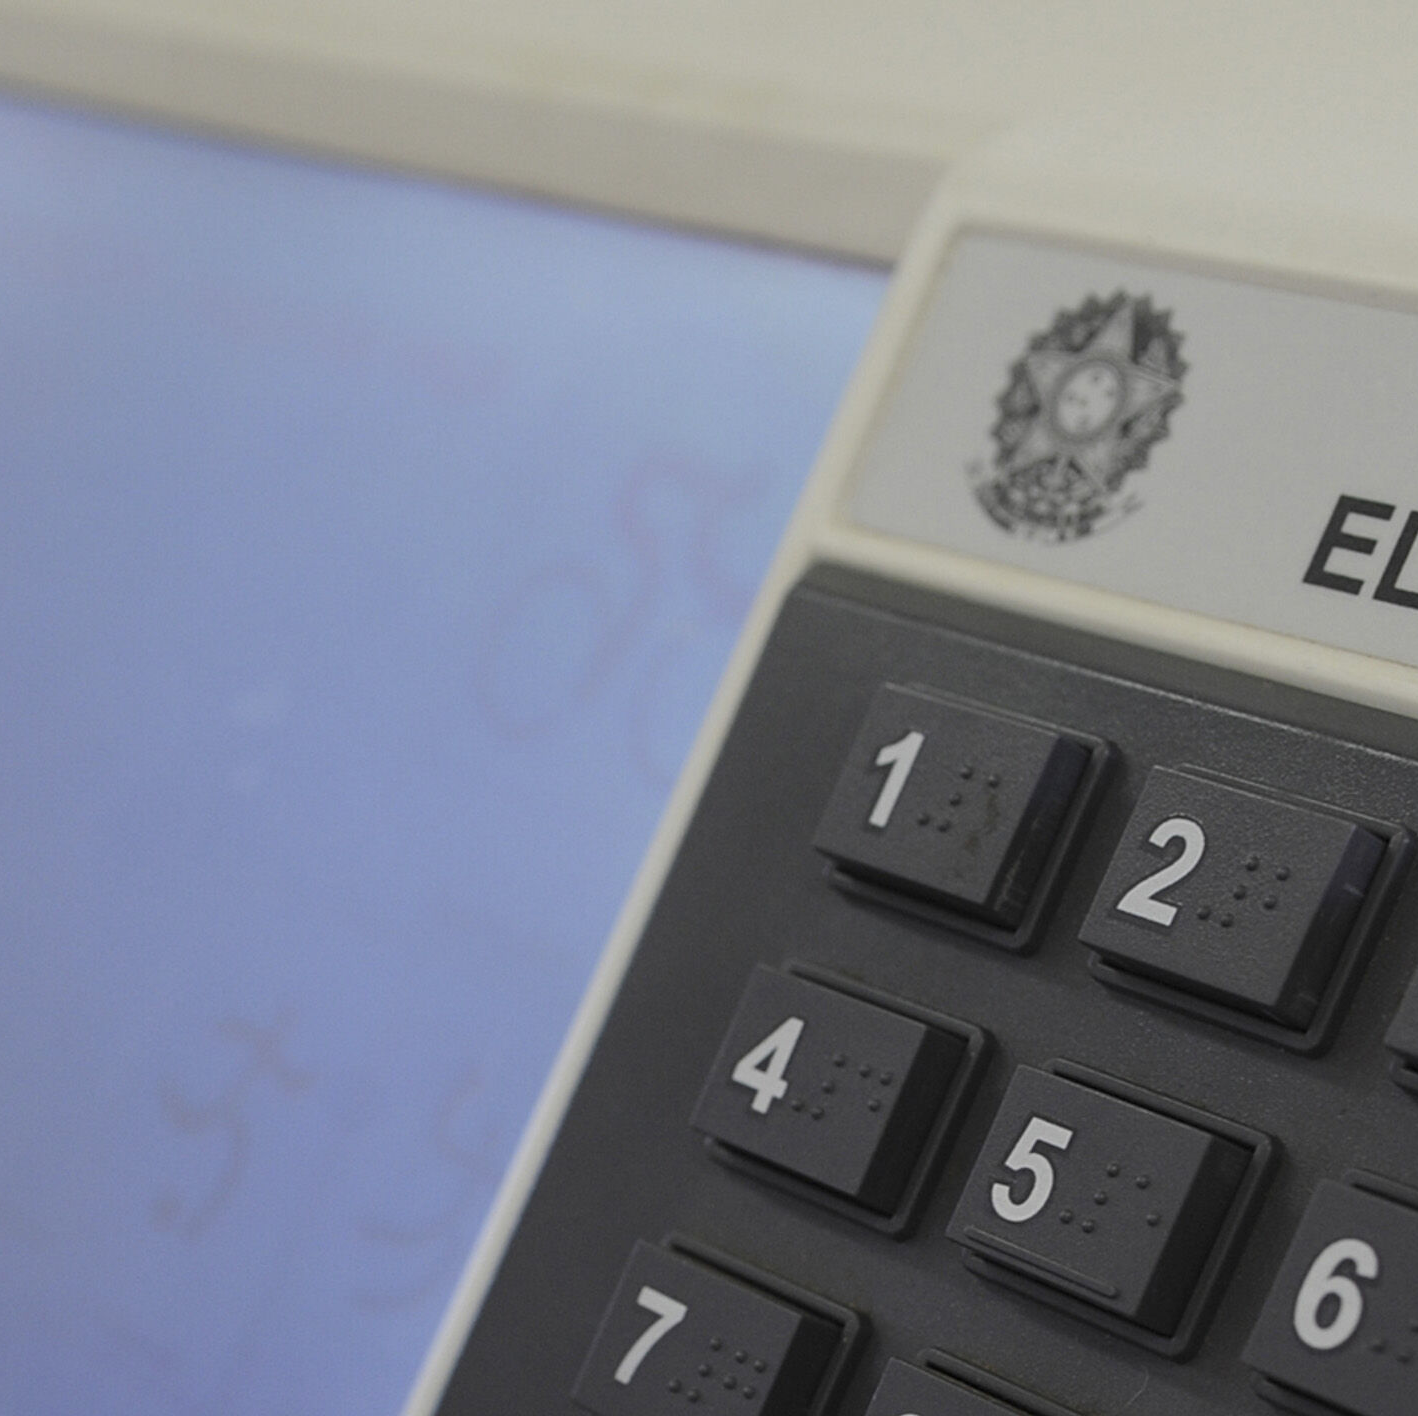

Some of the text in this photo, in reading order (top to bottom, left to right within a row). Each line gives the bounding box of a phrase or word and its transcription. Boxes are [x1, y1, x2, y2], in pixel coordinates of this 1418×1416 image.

[868, 730, 926, 828] 1
[1115, 817, 1206, 928] 2
[731, 1016, 805, 1115] 4
[990, 1115, 1074, 1223] 5
[614, 1285, 688, 1385] 7
[1293, 1238, 1379, 1350] 6
